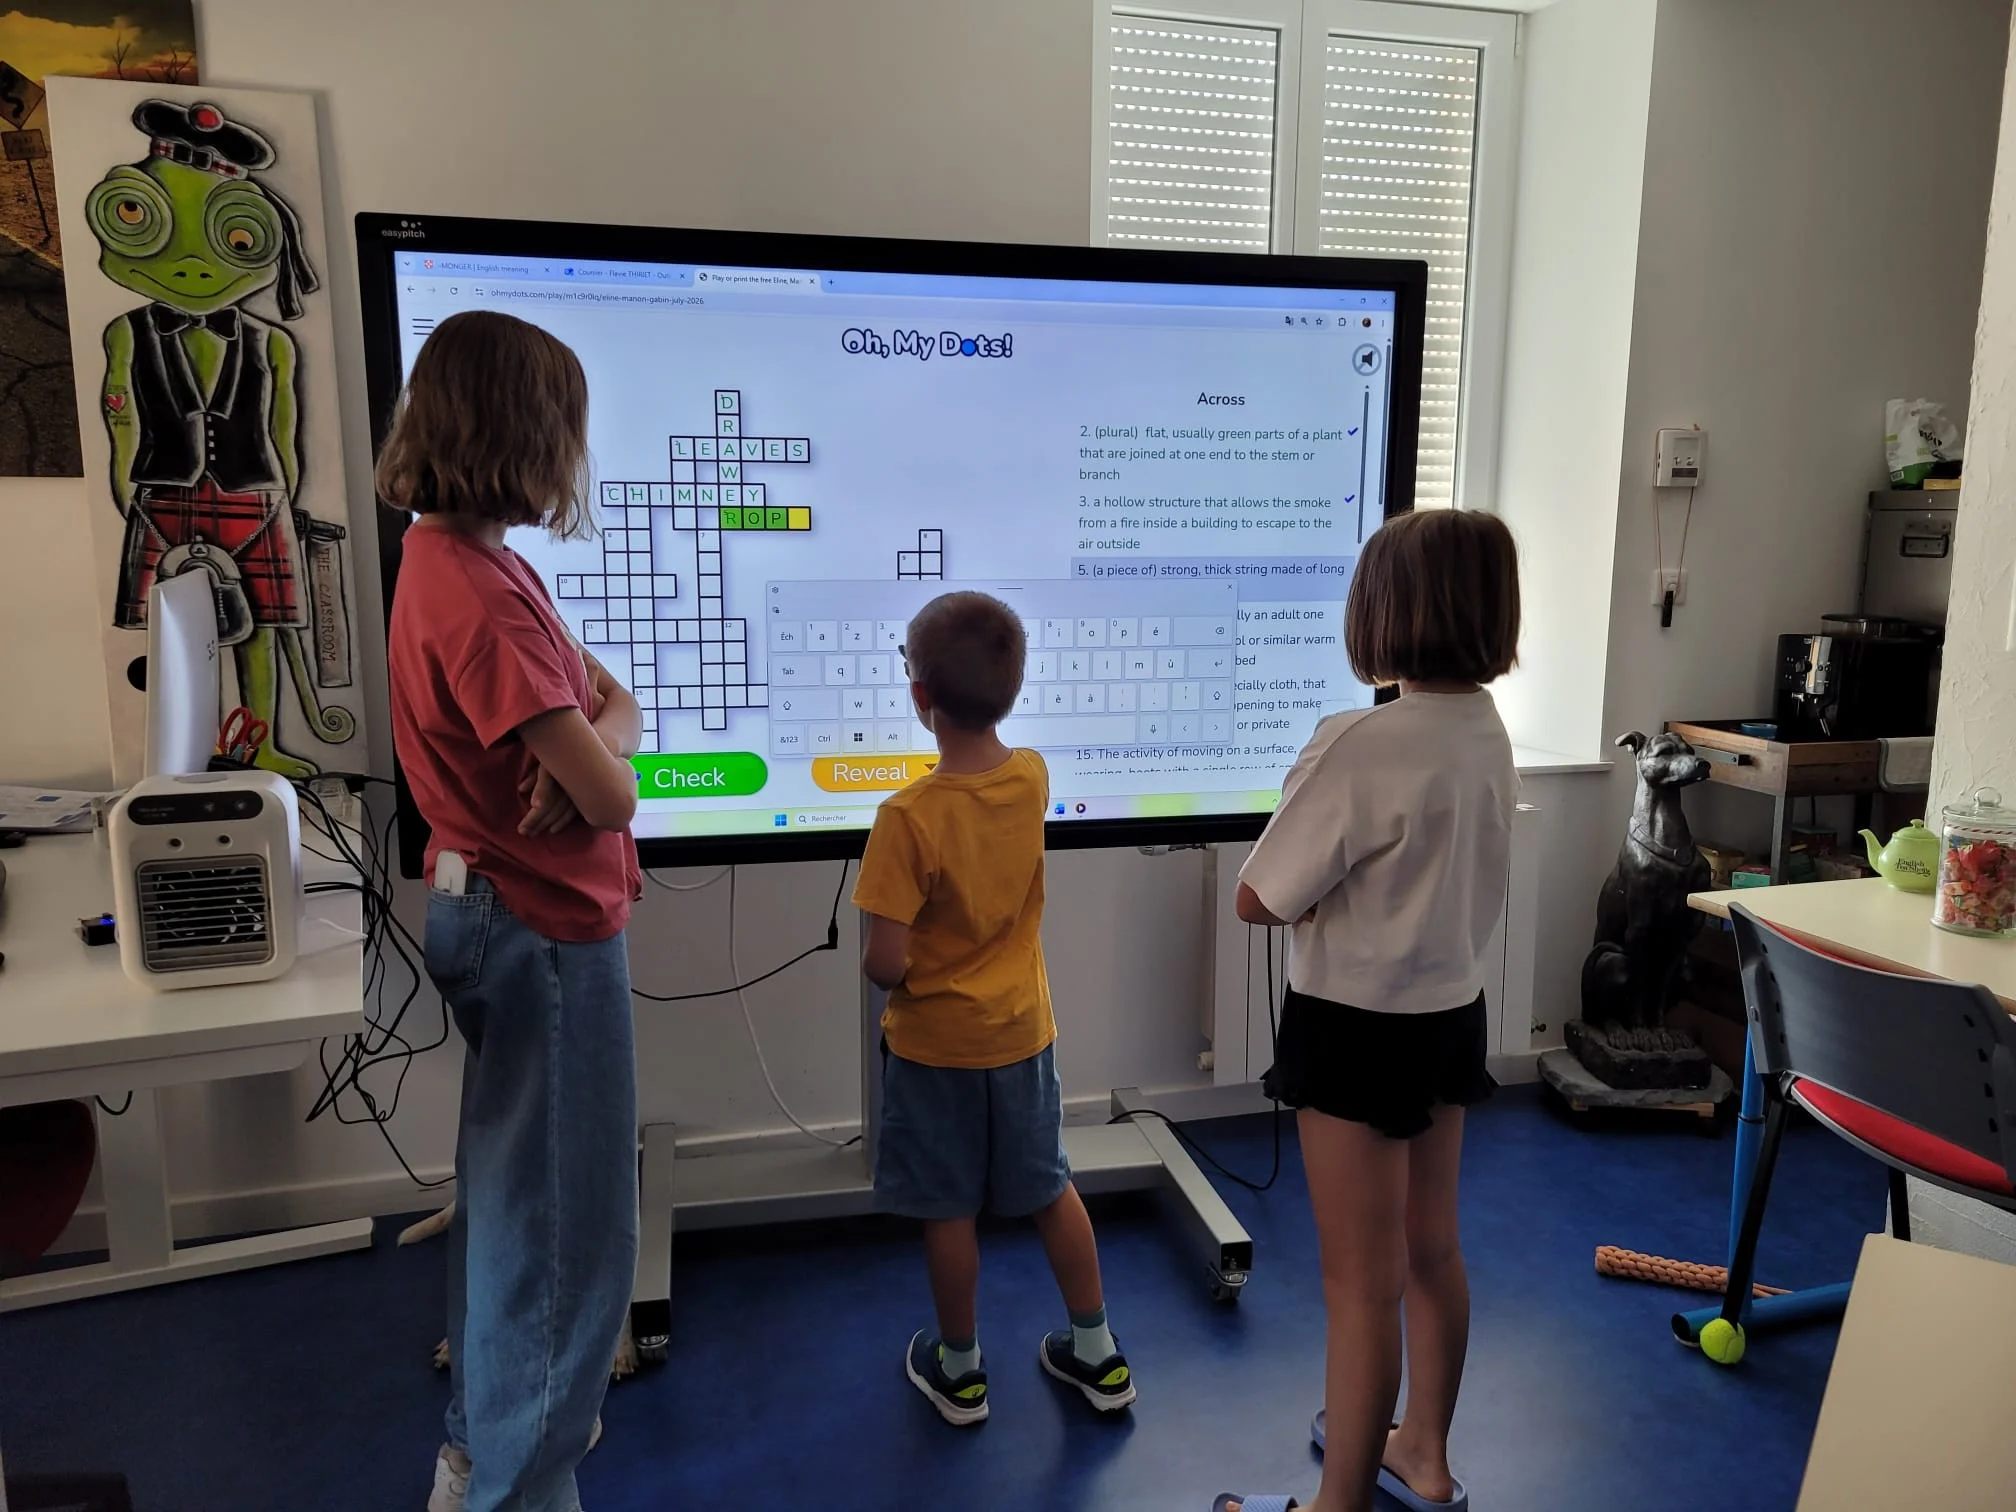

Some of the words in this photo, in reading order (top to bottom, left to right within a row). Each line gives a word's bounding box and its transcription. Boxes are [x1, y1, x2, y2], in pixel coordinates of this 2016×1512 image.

[381, 228, 426, 239] easypitch
[476, 264, 500, 274] English
[501, 266, 529, 275] meaning
[711, 274, 725, 283] Play
[733, 276, 748, 284] print
[760, 276, 772, 284] free
[841, 327, 890, 359] Oh,
[893, 329, 936, 361] My
[1196, 391, 1246, 406] Across
[1079, 425, 1092, 438] 2.
[1095, 425, 1139, 440] (plural)
[1145, 426, 1170, 440] flat,
[1171, 427, 1215, 441] usually
[1217, 430, 1251, 442] green
[1254, 429, 1285, 442] parts
[1287, 428, 1301, 441] of
[1302, 431, 1310, 441] a
[1312, 428, 1343, 442] plant
[1079, 447, 1105, 459] that
[1107, 450, 1127, 460] are
[1128, 447, 1166, 461] joined
[1169, 449, 1181, 460] at
[1183, 450, 1206, 461] one
[1208, 448, 1231, 461] end
[1234, 450, 1247, 461] to
[1249, 449, 1269, 461] the
[1271, 450, 1300, 461] stem
[1302, 451, 1316, 461] or
[1079, 468, 1120, 481] branch
[1079, 495, 1090, 508] 3.
[1093, 497, 1101, 508] a
[1104, 495, 1146, 508] hollow
[1148, 496, 1201, 509] structure
[1203, 496, 1229, 509] that
[1231, 496, 1270, 509] allows
[1272, 496, 1292, 509] the
[1293, 496, 1332, 509] smoke
[1078, 516, 1107, 529] from
[1110, 519, 1117, 529] a
[1120, 516, 1140, 529] fire
[1143, 516, 1178, 529] inside
[1180, 519, 1188, 529] a
[1191, 516, 1238, 531] building
[1241, 517, 1253, 529] to
[1255, 518, 1296, 531] escape
[1299, 517, 1311, 529] to
[1313, 517, 1332, 529] the
[1078, 537, 1094, 550] air
[1096, 537, 1141, 550] outside
[316, 547, 331, 573] THE
[1078, 564, 1090, 577] 5.
[1093, 563, 1104, 577] (a
[1107, 564, 1137, 579] piece
[1141, 563, 1157, 577] of)
[1160, 564, 1201, 579] strong,
[1204, 563, 1232, 576] thick
[1235, 563, 1268, 577] string
[1271, 563, 1302, 576] made
[1305, 563, 1318, 575] of
[1320, 562, 1345, 577] long
[1254, 610, 1269, 621] an
[1271, 608, 1301, 621] adult
[1303, 609, 1325, 620] one
[844, 623, 850, 631] 2
[879, 622, 885, 630] 3
[819, 632, 825, 641] a
[854, 632, 860, 640] z
[889, 631, 895, 640] e
[1088, 629, 1095, 637] o
[1121, 629, 1128, 639] p
[1153, 627, 1159, 636] é
[1248, 635, 1261, 646] or
[1263, 633, 1302, 646] similar
[1304, 635, 1336, 645] warm
[1235, 654, 1256, 666] bed
[782, 666, 795, 676] Tab
[837, 666, 844, 677] q
[872, 666, 878, 674] s
[1072, 661, 1079, 671] k
[1135, 662, 1144, 670] m
[1167, 659, 1174, 669] ù
[1269, 678, 1300, 691] cloth,
[1302, 678, 1326, 690] that
[1023, 696, 1029, 705] n
[1234, 699, 1275, 713] pening
[1277, 699, 1290, 710] to
[1292, 697, 1322, 710] make
[1236, 720, 1249, 731] or
[1251, 718, 1290, 732] private
[780, 735, 799, 744] &123
[817, 734, 831, 743] Ctrl
[887, 733, 898, 742] Alt
[1075, 749, 1094, 761] 15.
[1098, 747, 1120, 760] The
[1122, 746, 1164, 763] activity
[1167, 746, 1180, 758] of
[1181, 745, 1224, 760] moving
[1226, 746, 1241, 757] on
[1243, 746, 1251, 756] a
[1253, 742, 1297, 757] surface,
[653, 765, 727, 789] Check
[832, 761, 910, 783] Reveal
[810, 812, 847, 823] Rechercher
